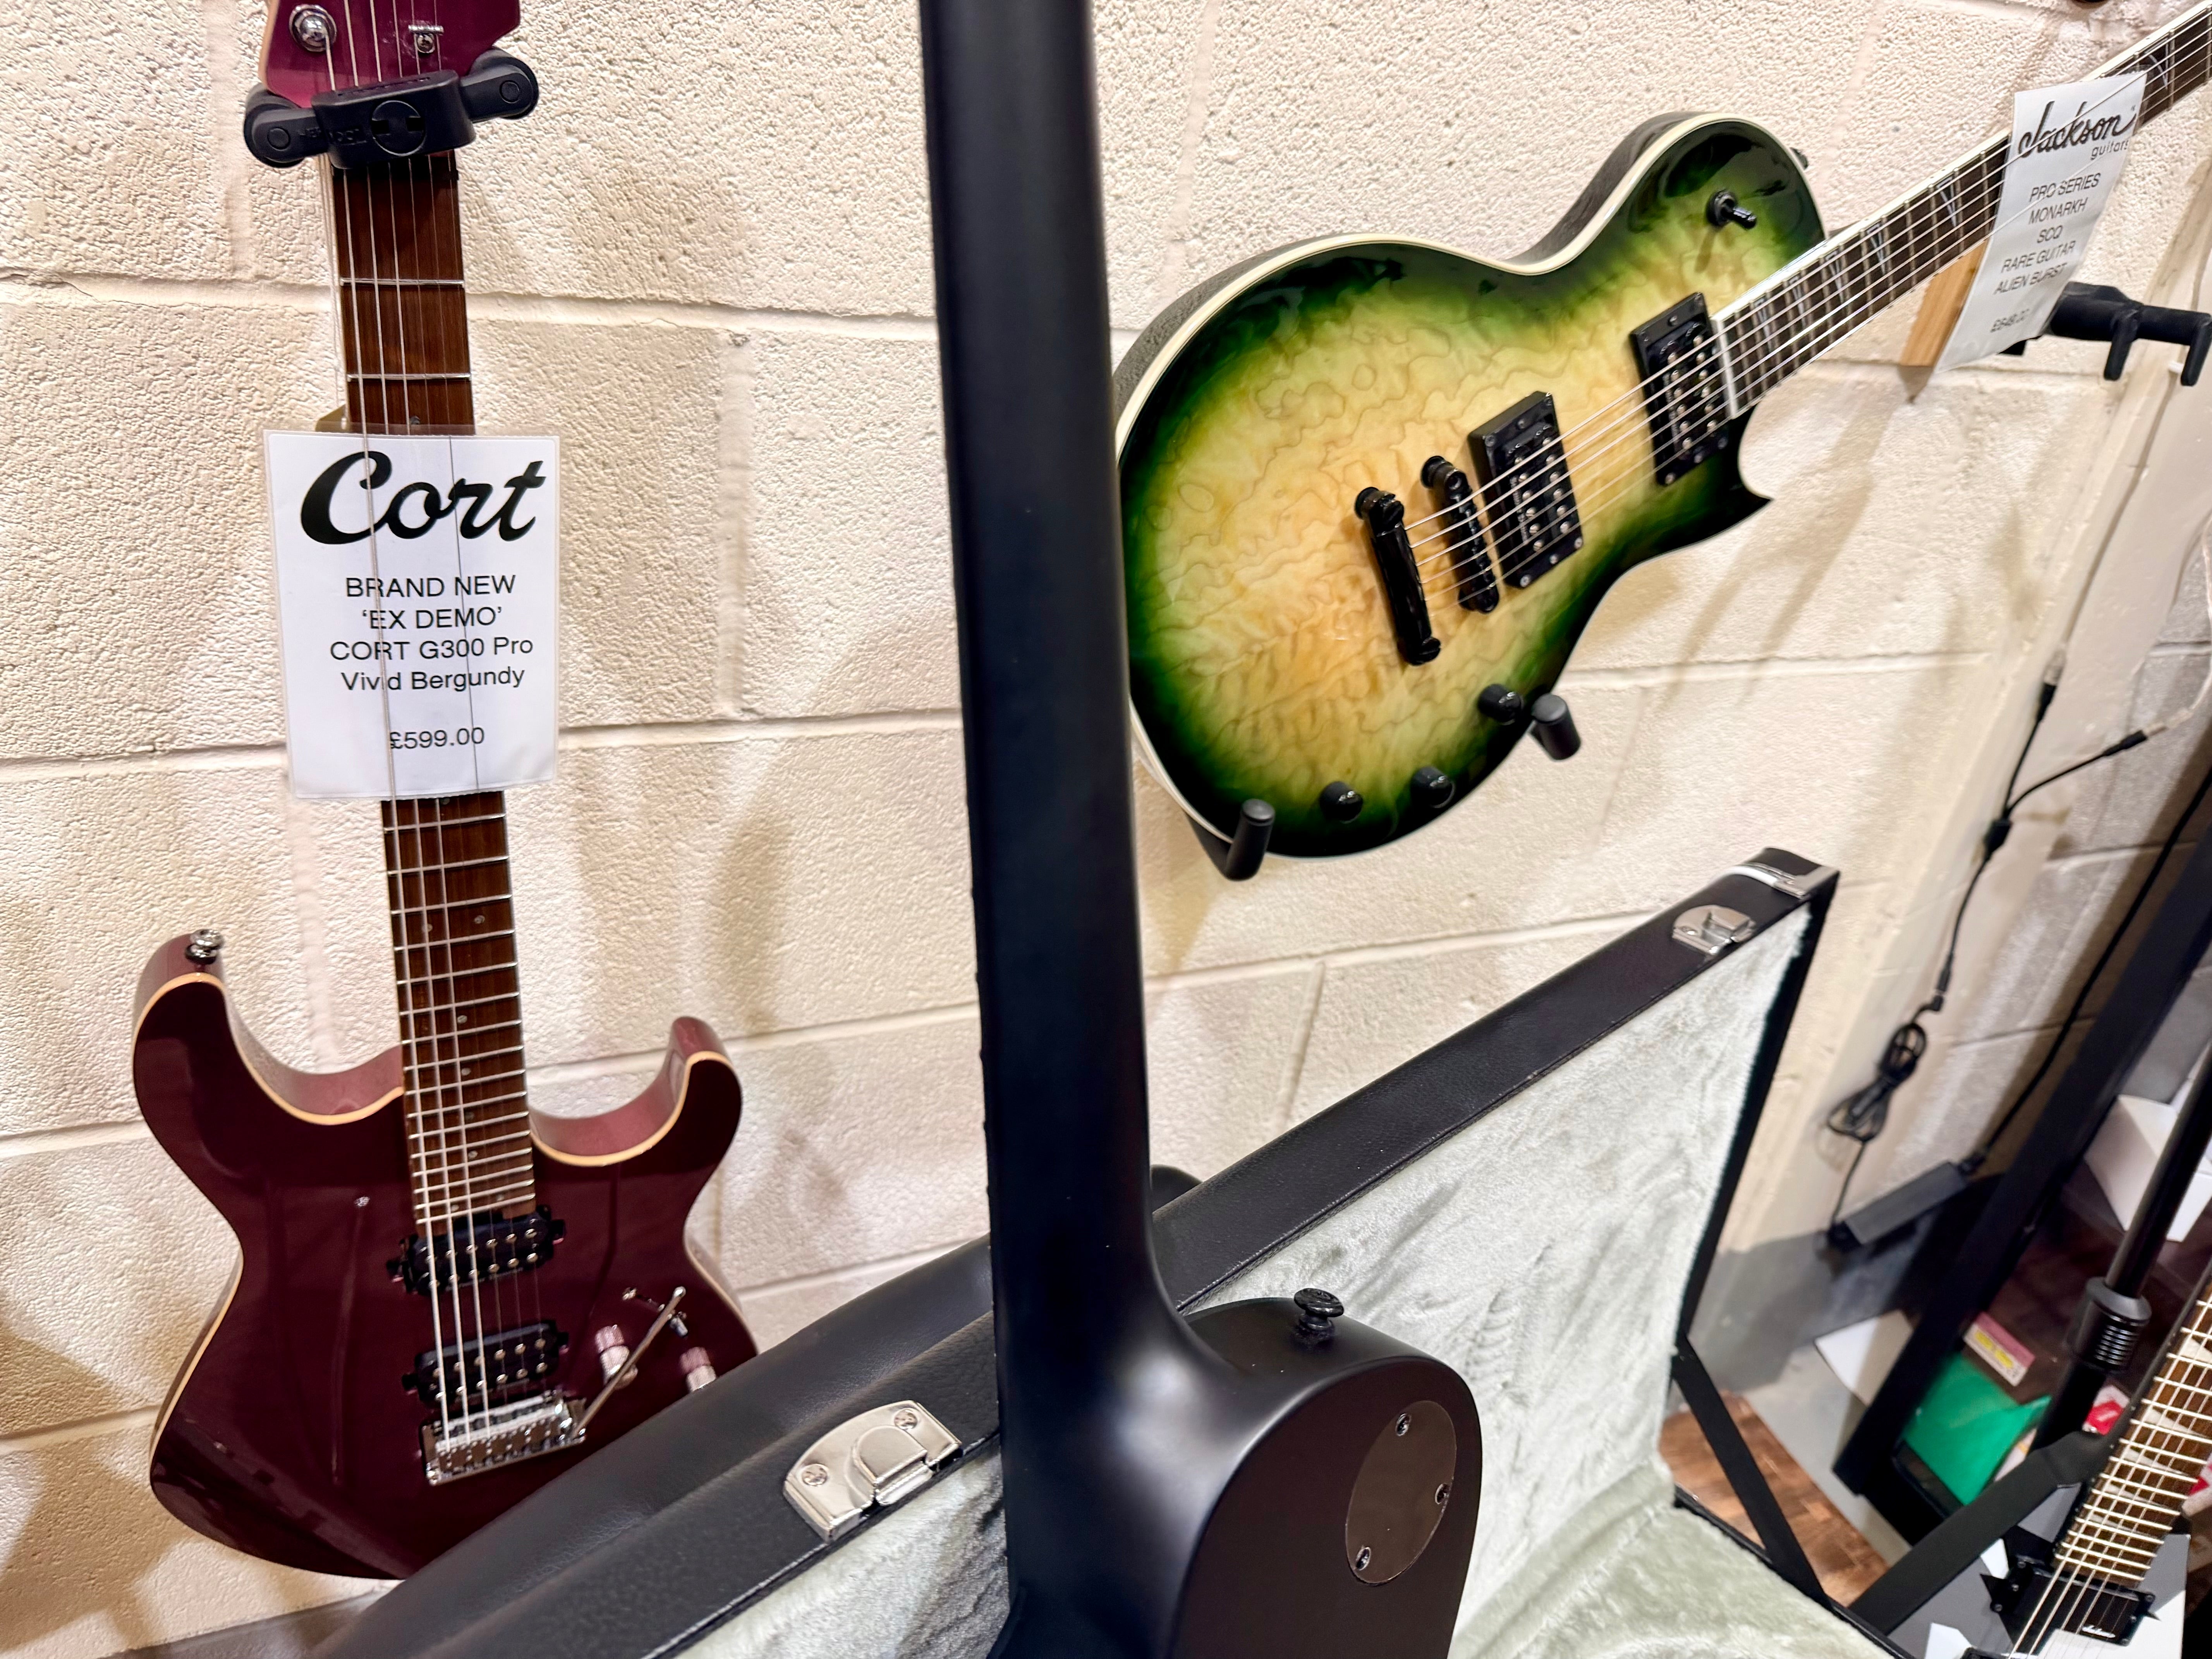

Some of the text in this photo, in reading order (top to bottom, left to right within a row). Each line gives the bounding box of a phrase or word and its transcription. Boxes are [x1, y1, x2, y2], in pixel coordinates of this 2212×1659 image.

[2018, 100, 2137, 158] Jackson
[2029, 173, 2101, 202] PRO SERIES
[2028, 197, 2088, 225] MONARKH
[2001, 240, 2076, 273] RARE GUITAR
[301, 450, 546, 544] Cort
[346, 575, 516, 598] BRAND NEW
[330, 637, 533, 660] CORT G300 Pro
[411, 666, 525, 692] Bergundy
[389, 727, 485, 749] £599.00
